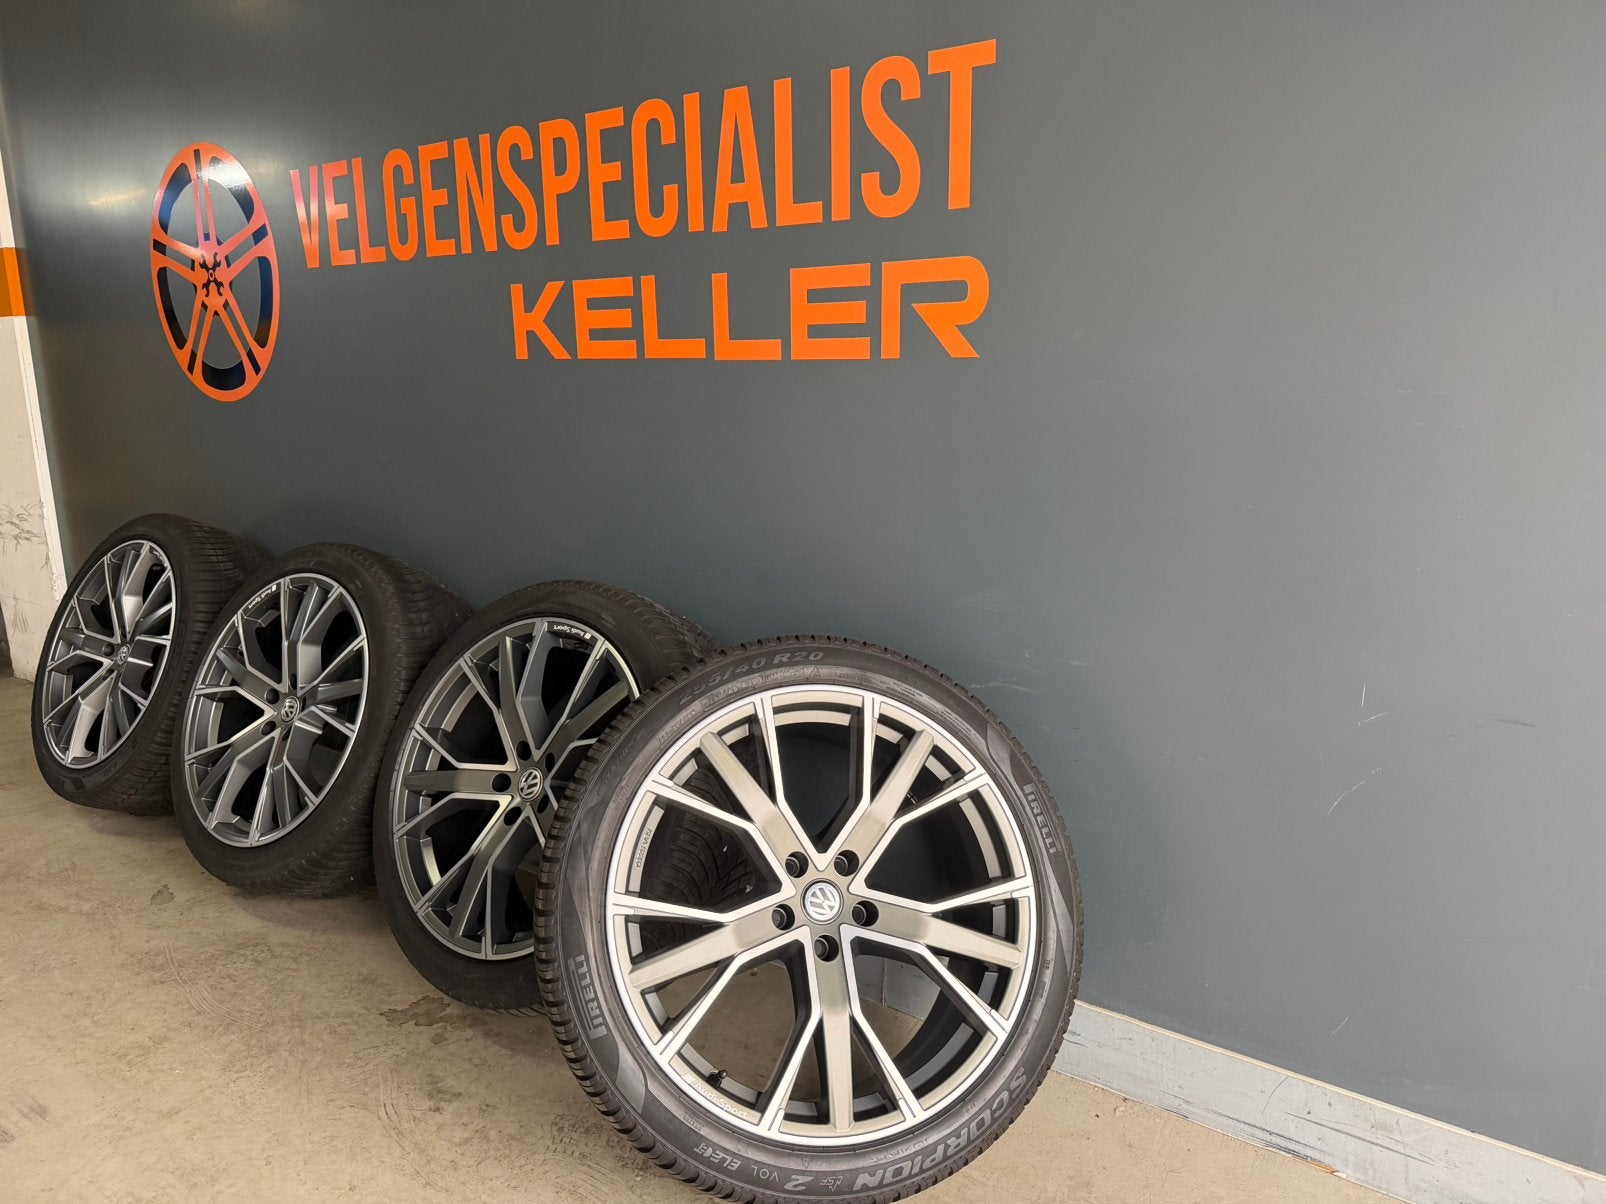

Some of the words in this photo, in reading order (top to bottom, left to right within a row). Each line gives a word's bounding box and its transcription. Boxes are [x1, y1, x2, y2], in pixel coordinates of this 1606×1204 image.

[290, 40, 996, 269] VELGENSPECIALIST
[511, 256, 990, 361] KELLER
[679, 657, 766, 705] 255/40
[773, 651, 824, 664] R20
[1023, 782, 1060, 854] PIRELLI
[568, 954, 608, 1040] PIRELLI
[694, 1083, 718, 1100] Audi
[718, 1098, 749, 1118] Sport
[852, 1066, 1027, 1191] SCORPION
[751, 1164, 779, 1182] VOL
